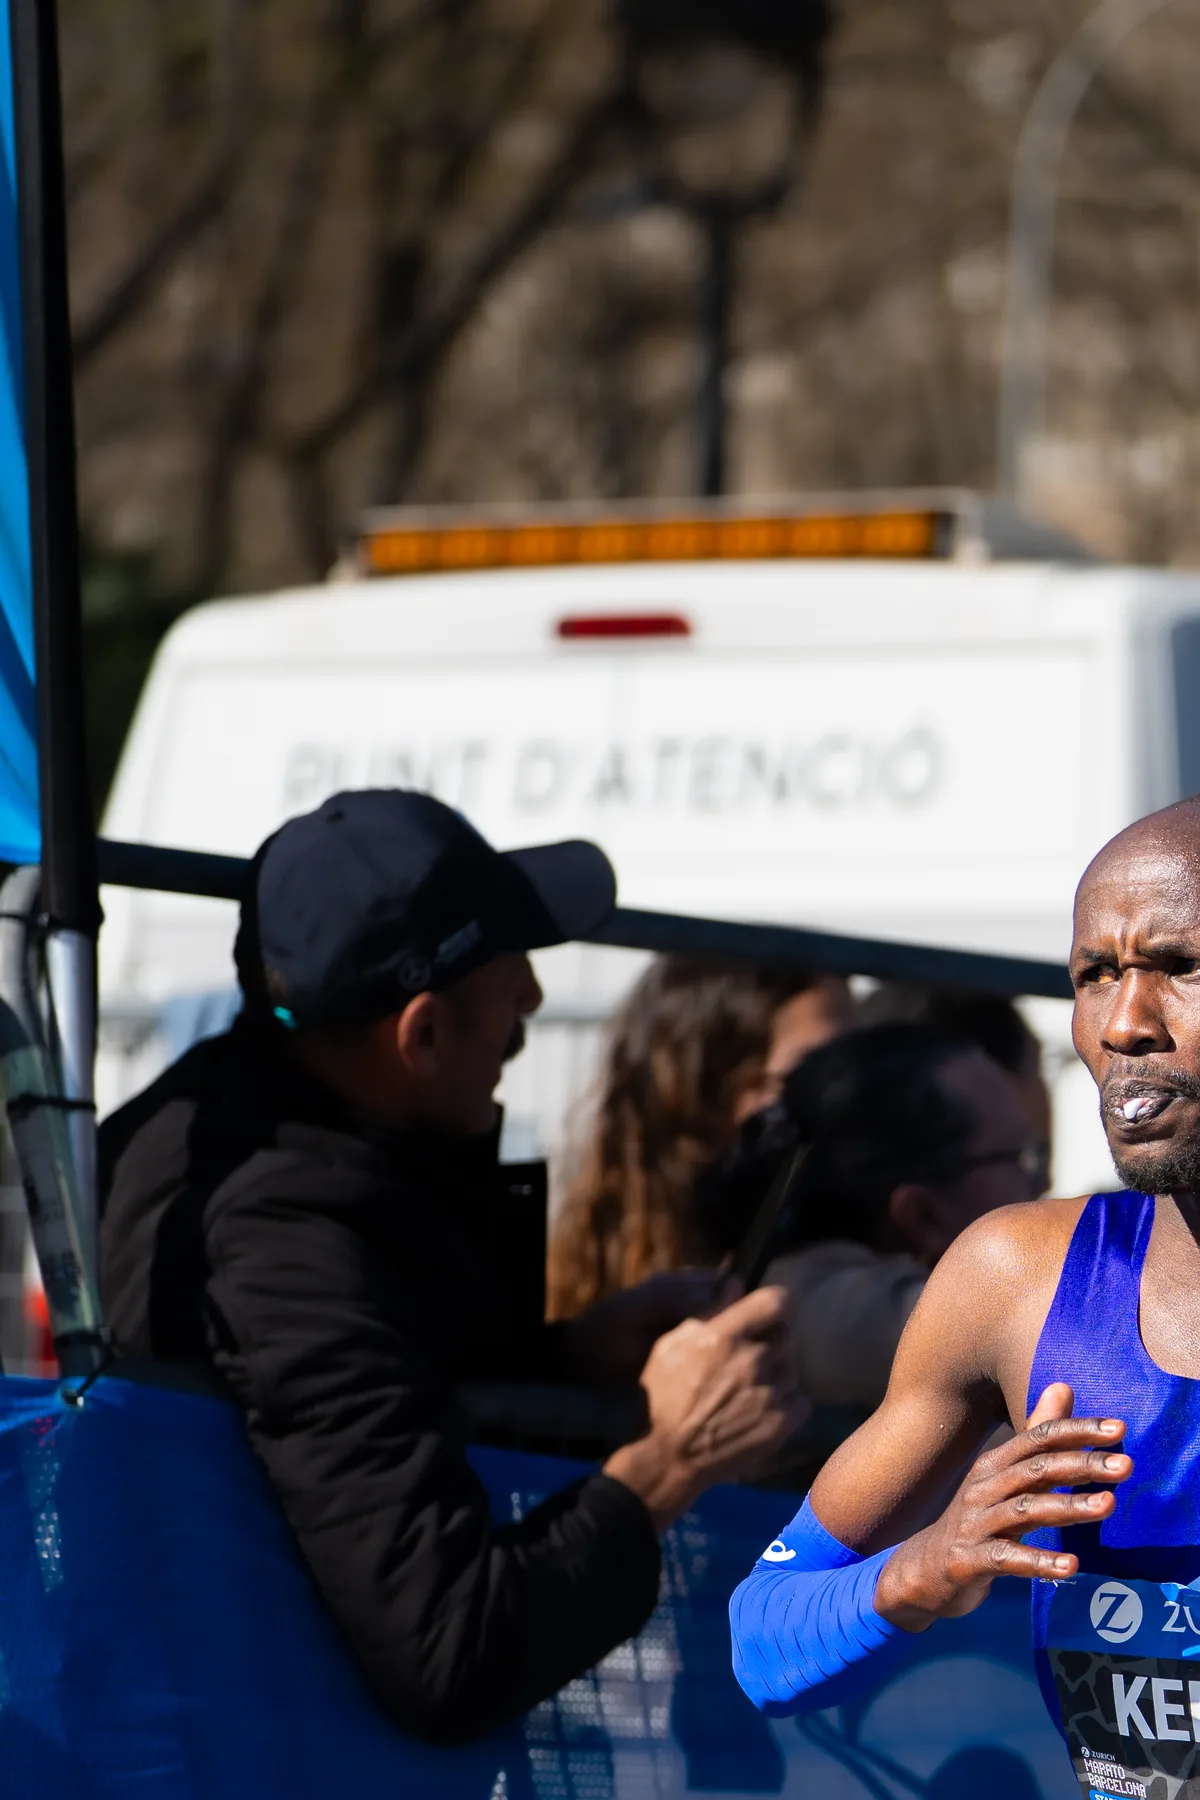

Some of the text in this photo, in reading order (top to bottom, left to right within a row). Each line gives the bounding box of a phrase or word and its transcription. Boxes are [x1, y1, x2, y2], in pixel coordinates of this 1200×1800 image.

[1091, 1750, 1116, 1761] ZURICH
[1083, 1758, 1126, 1780] MARATÓ
[1087, 1772, 1147, 1798] BARCELONA
